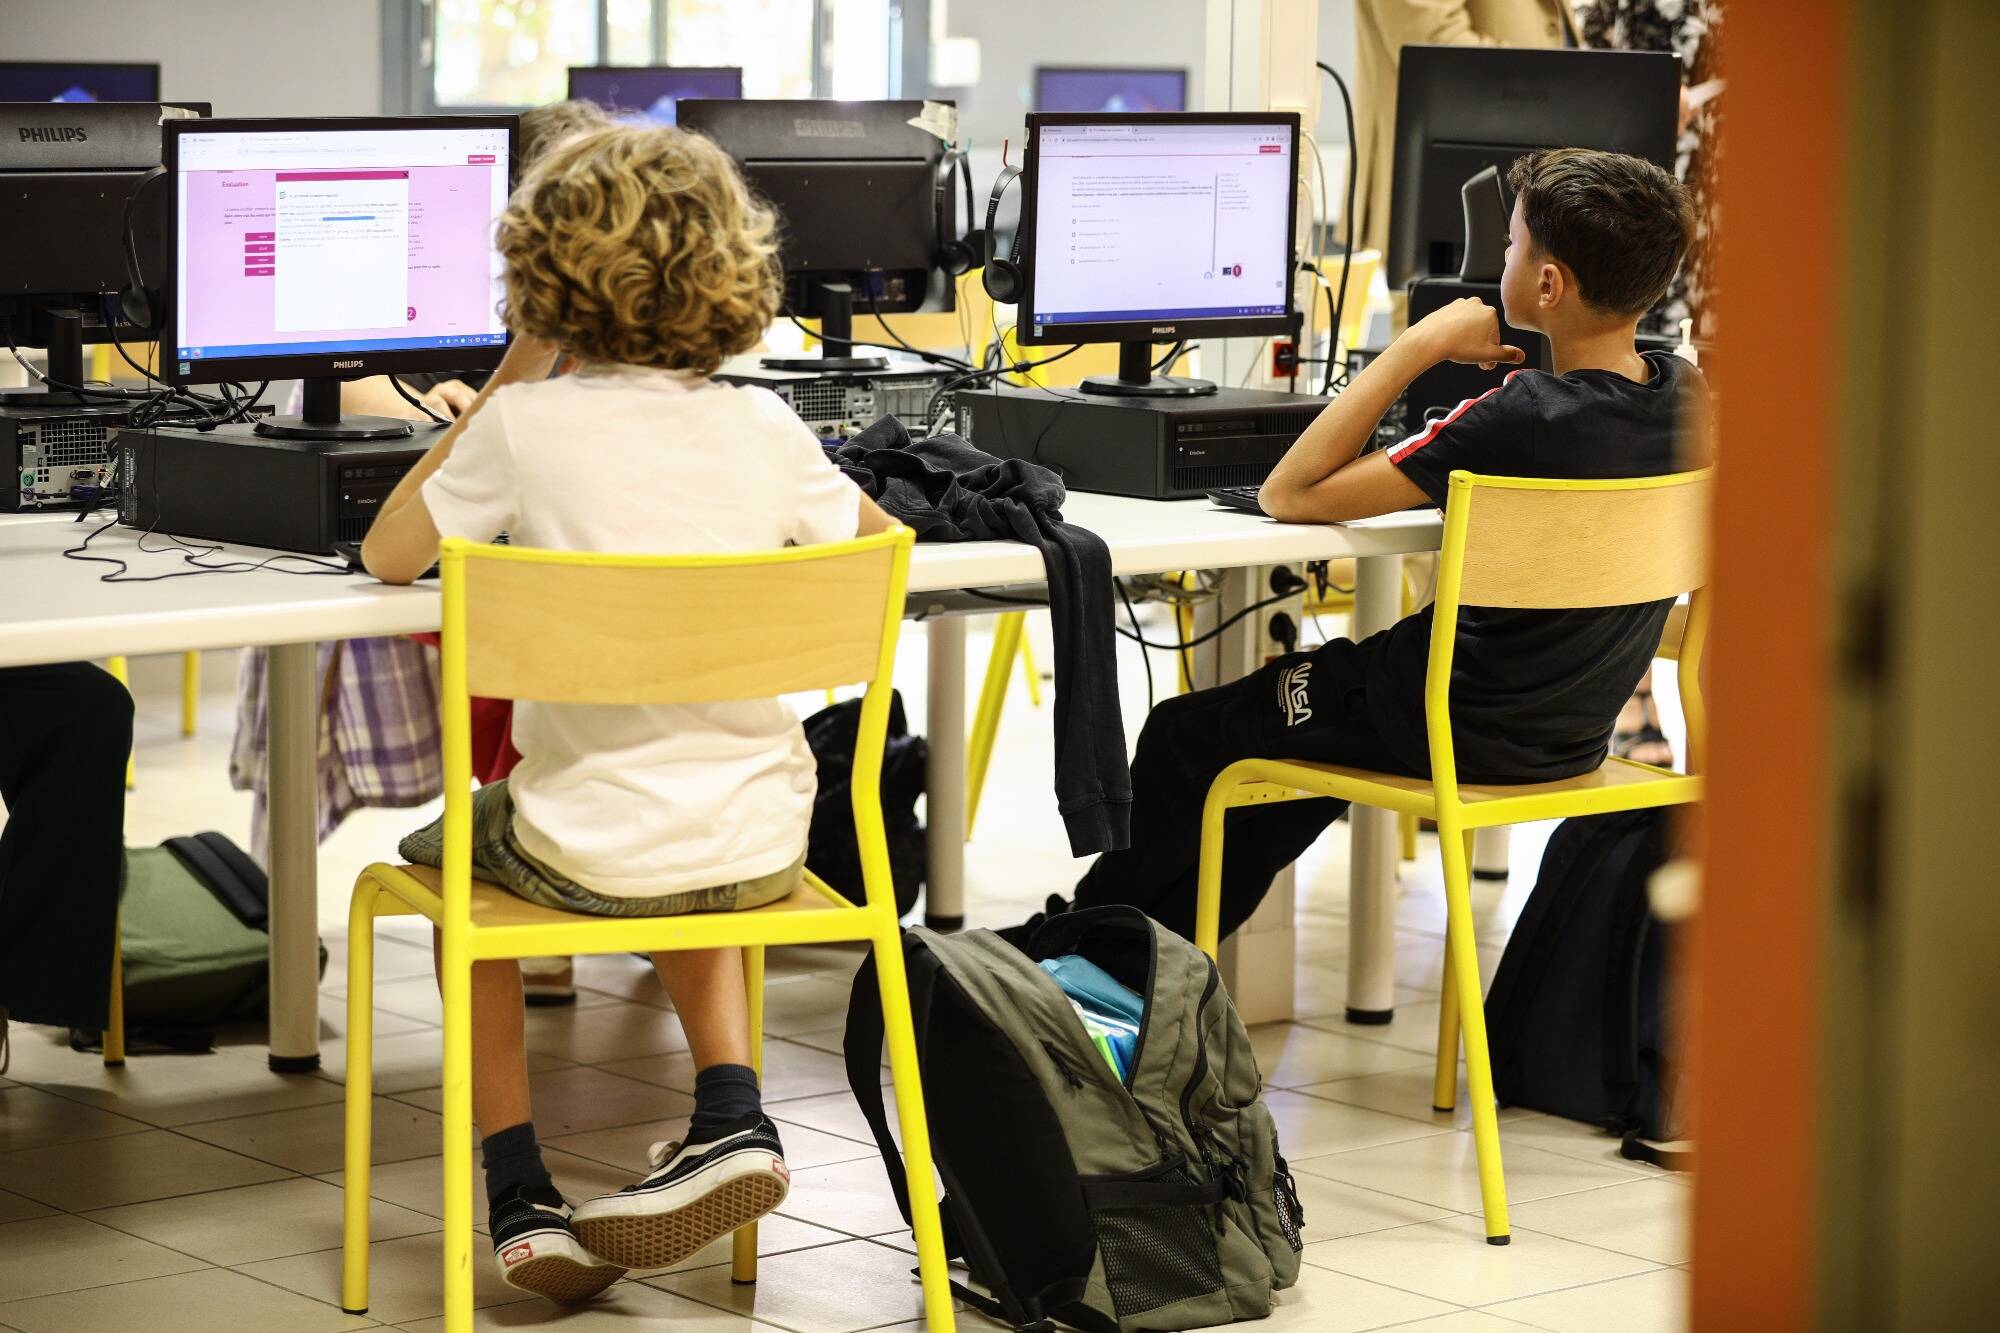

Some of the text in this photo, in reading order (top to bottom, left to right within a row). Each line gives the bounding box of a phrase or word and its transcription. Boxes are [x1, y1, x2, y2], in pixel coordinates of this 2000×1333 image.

[19, 127, 87, 142] PHILIPS
[1152, 326, 1176, 334] PHILIPS
[333, 360, 364, 369] PHILIPS
[1291, 662, 1313, 726] NASA
